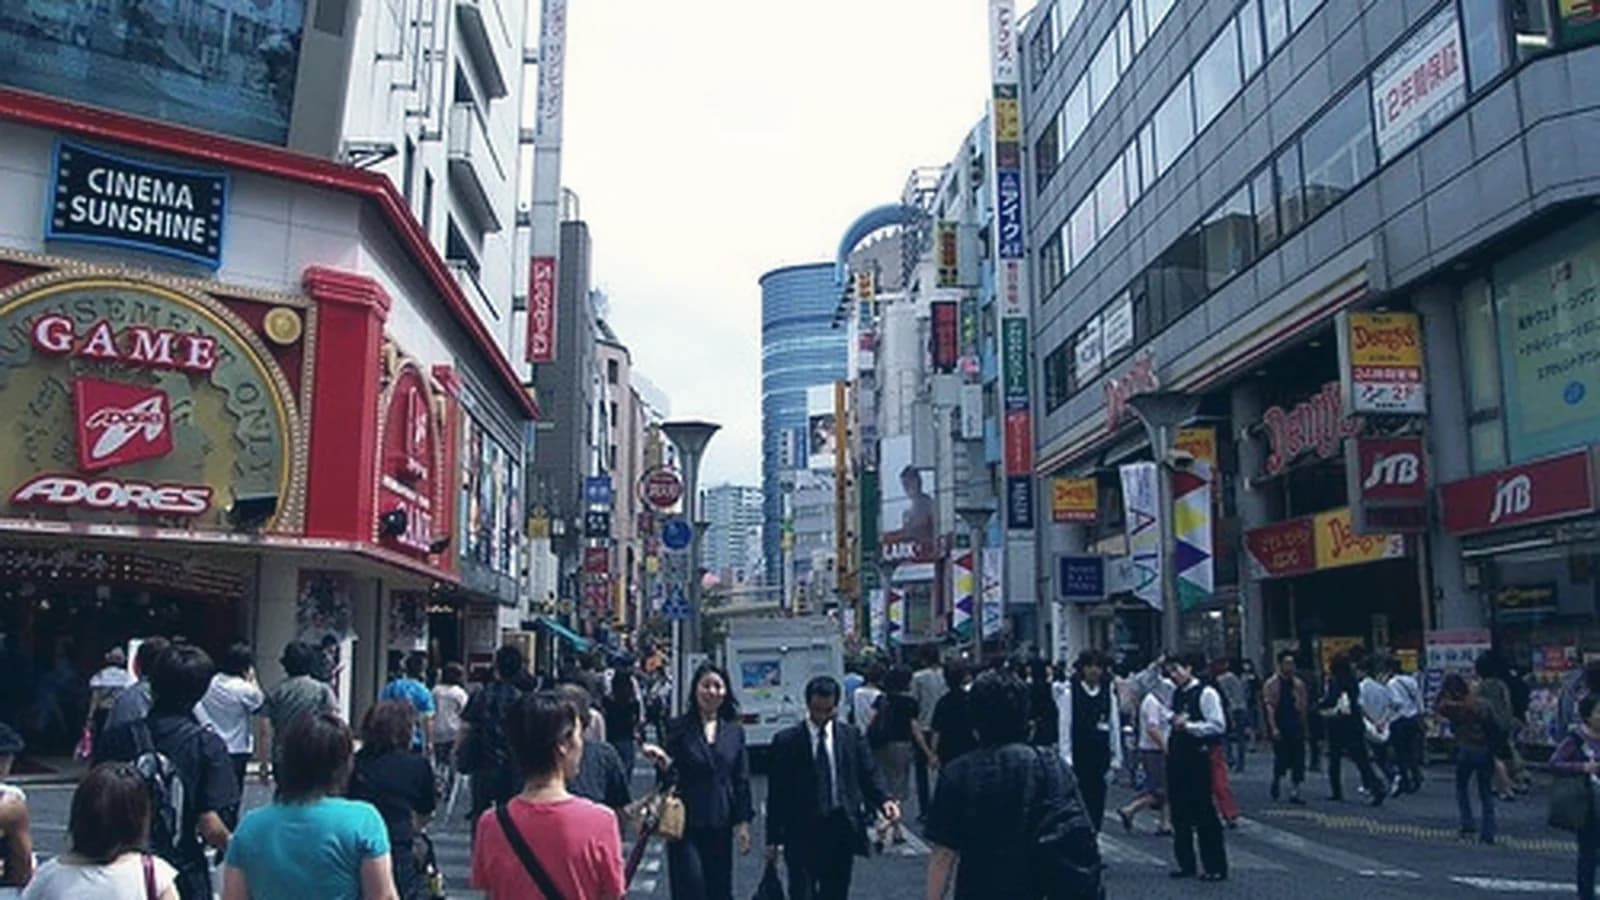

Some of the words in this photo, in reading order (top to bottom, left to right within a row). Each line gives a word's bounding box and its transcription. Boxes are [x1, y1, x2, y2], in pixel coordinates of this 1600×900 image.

[87, 168, 194, 211] CINEMA
[70, 195, 206, 244] SUNSHINE
[34, 315, 217, 370] GAME
[1364, 453, 1420, 489] JTB
[13, 476, 211, 513] ADORES
[1489, 474, 1532, 524] JTB
